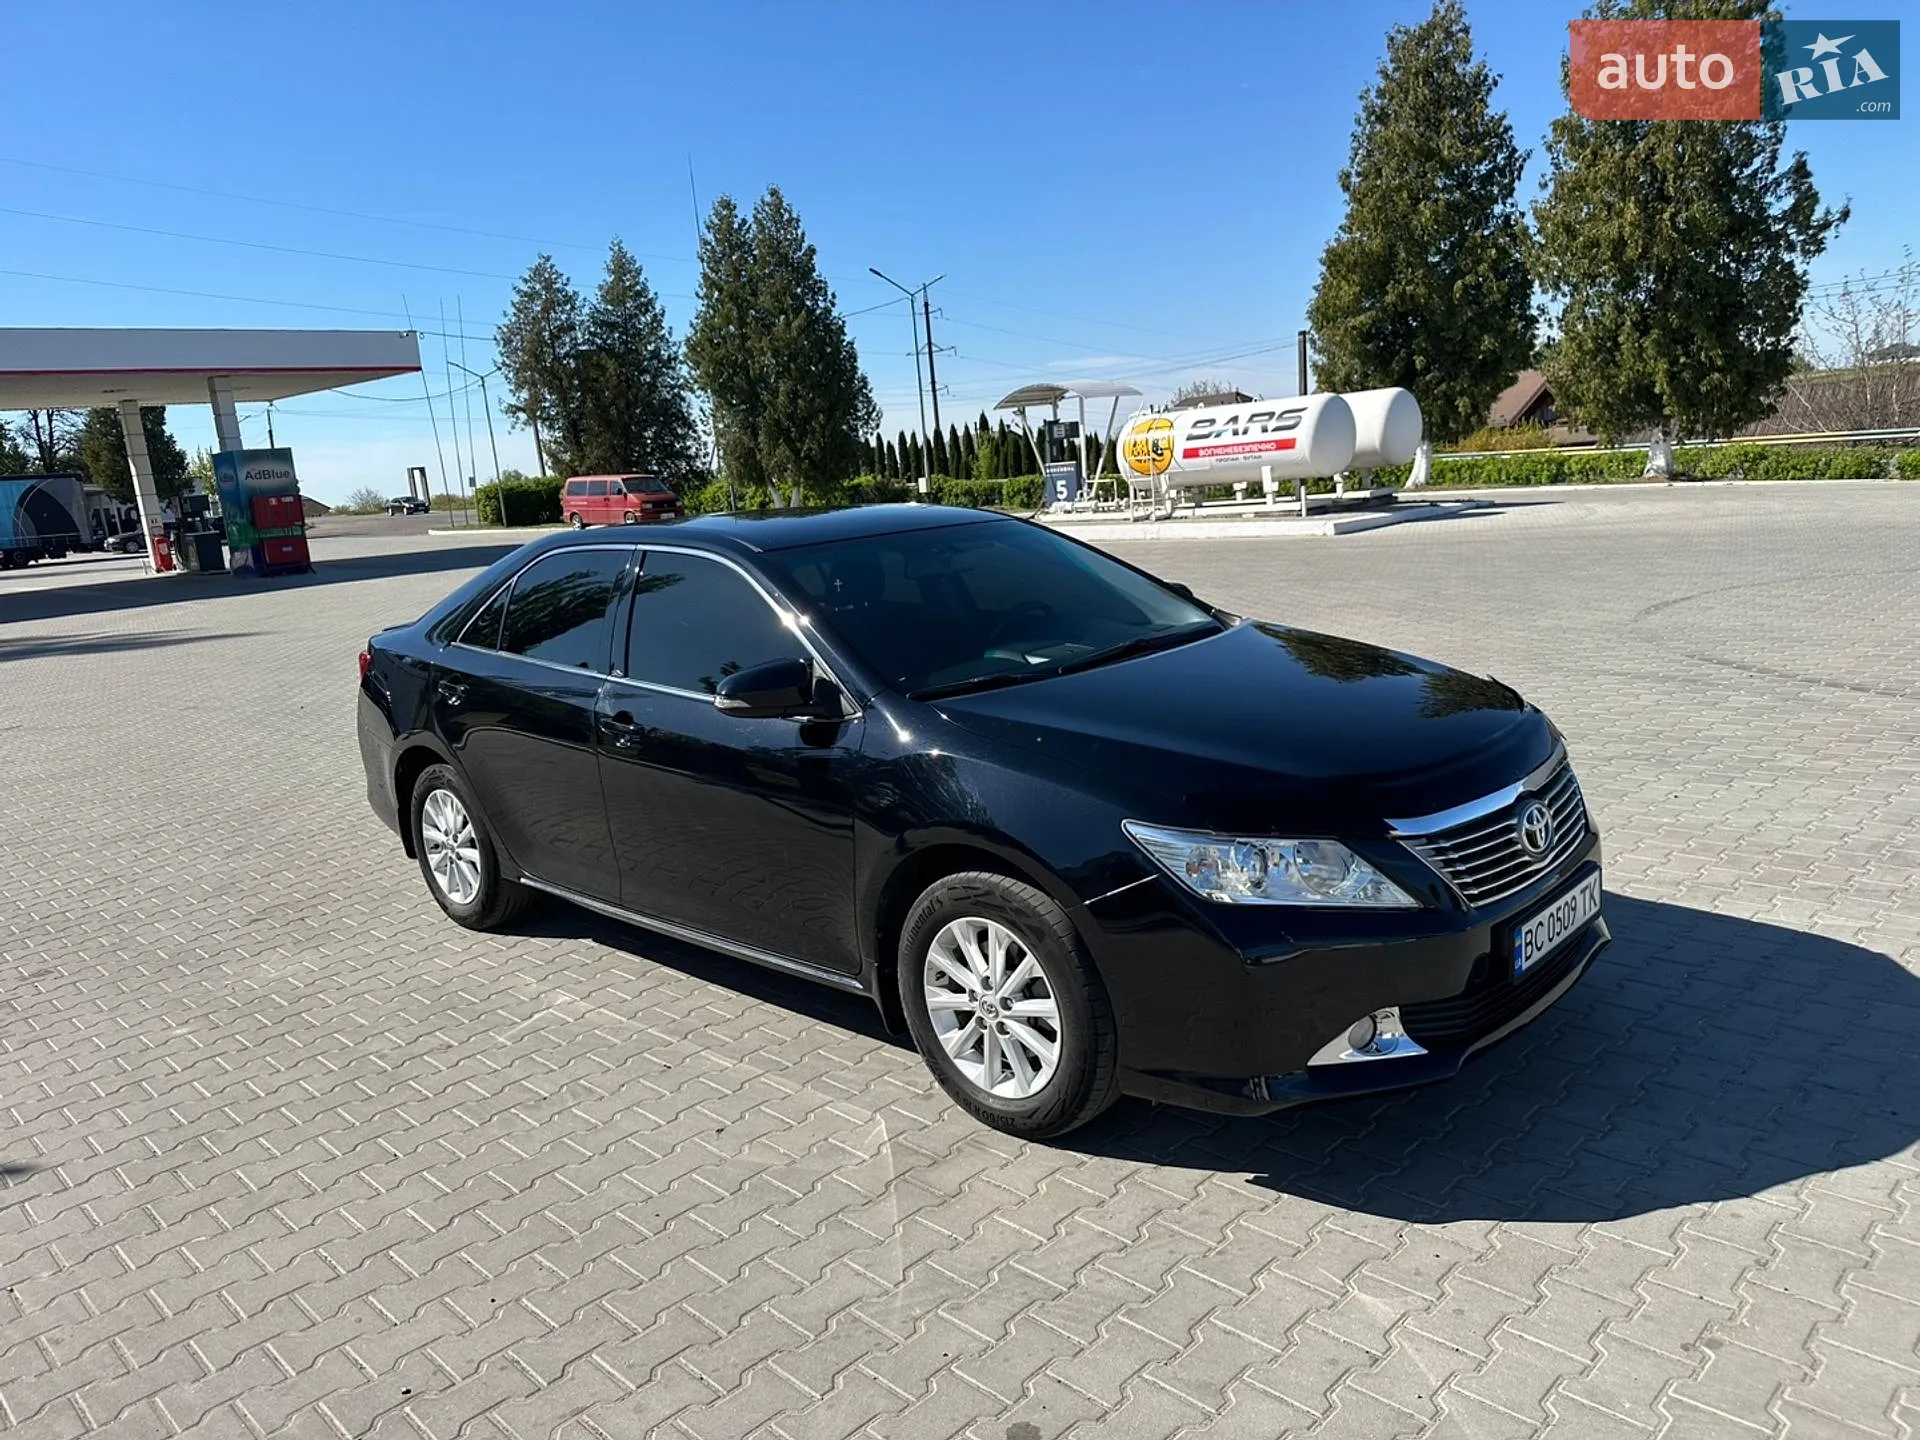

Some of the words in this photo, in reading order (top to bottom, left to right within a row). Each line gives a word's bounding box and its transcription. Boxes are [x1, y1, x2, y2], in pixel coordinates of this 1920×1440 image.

[1186, 406, 1309, 441] BARS
[245, 469, 291, 481] AdBlue
[1055, 479, 1069, 500] 5
[1524, 920, 1545, 962] BC
[1547, 896, 1578, 943] 0509
[1580, 878, 1598, 917] TK
